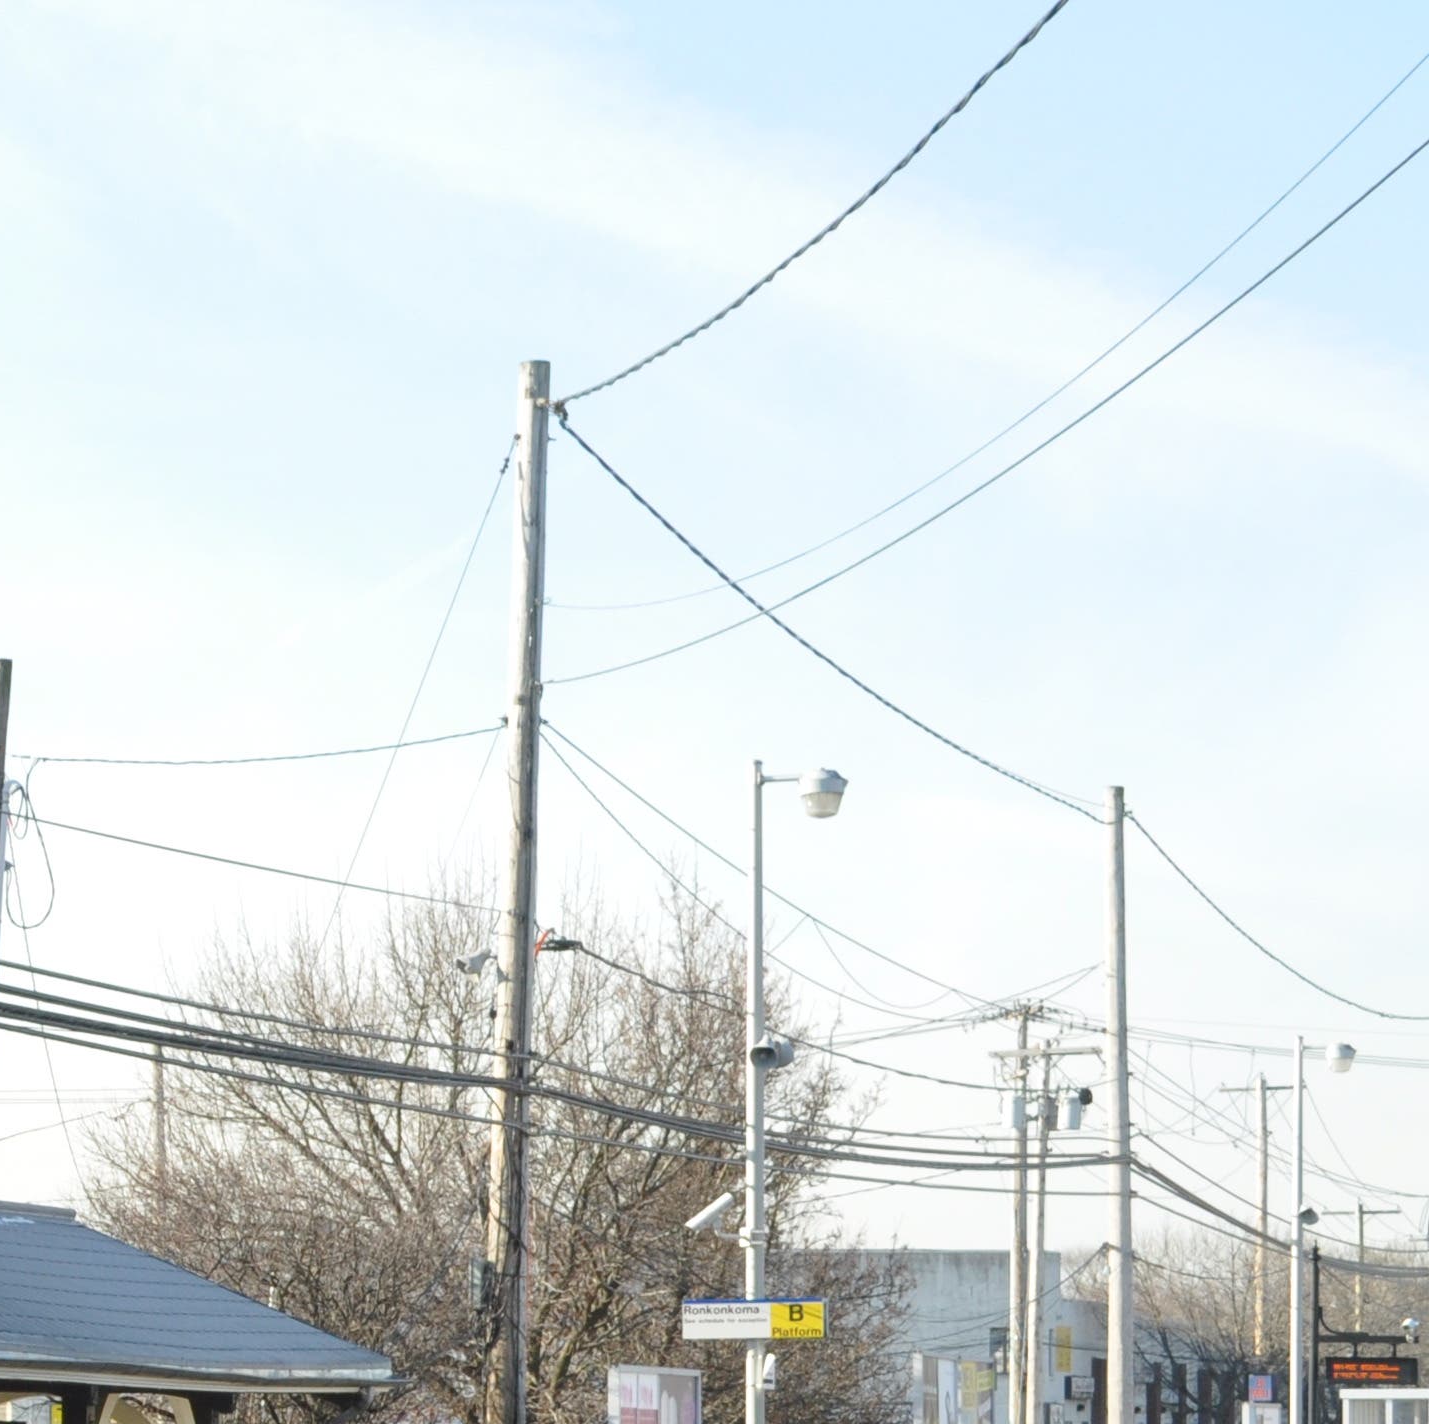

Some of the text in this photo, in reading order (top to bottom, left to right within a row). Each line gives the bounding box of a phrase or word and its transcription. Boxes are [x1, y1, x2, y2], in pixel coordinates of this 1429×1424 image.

[684, 1305, 760, 1315] Ronkonkoma
[789, 1304, 804, 1322] B
[772, 1326, 822, 1338] Platform
